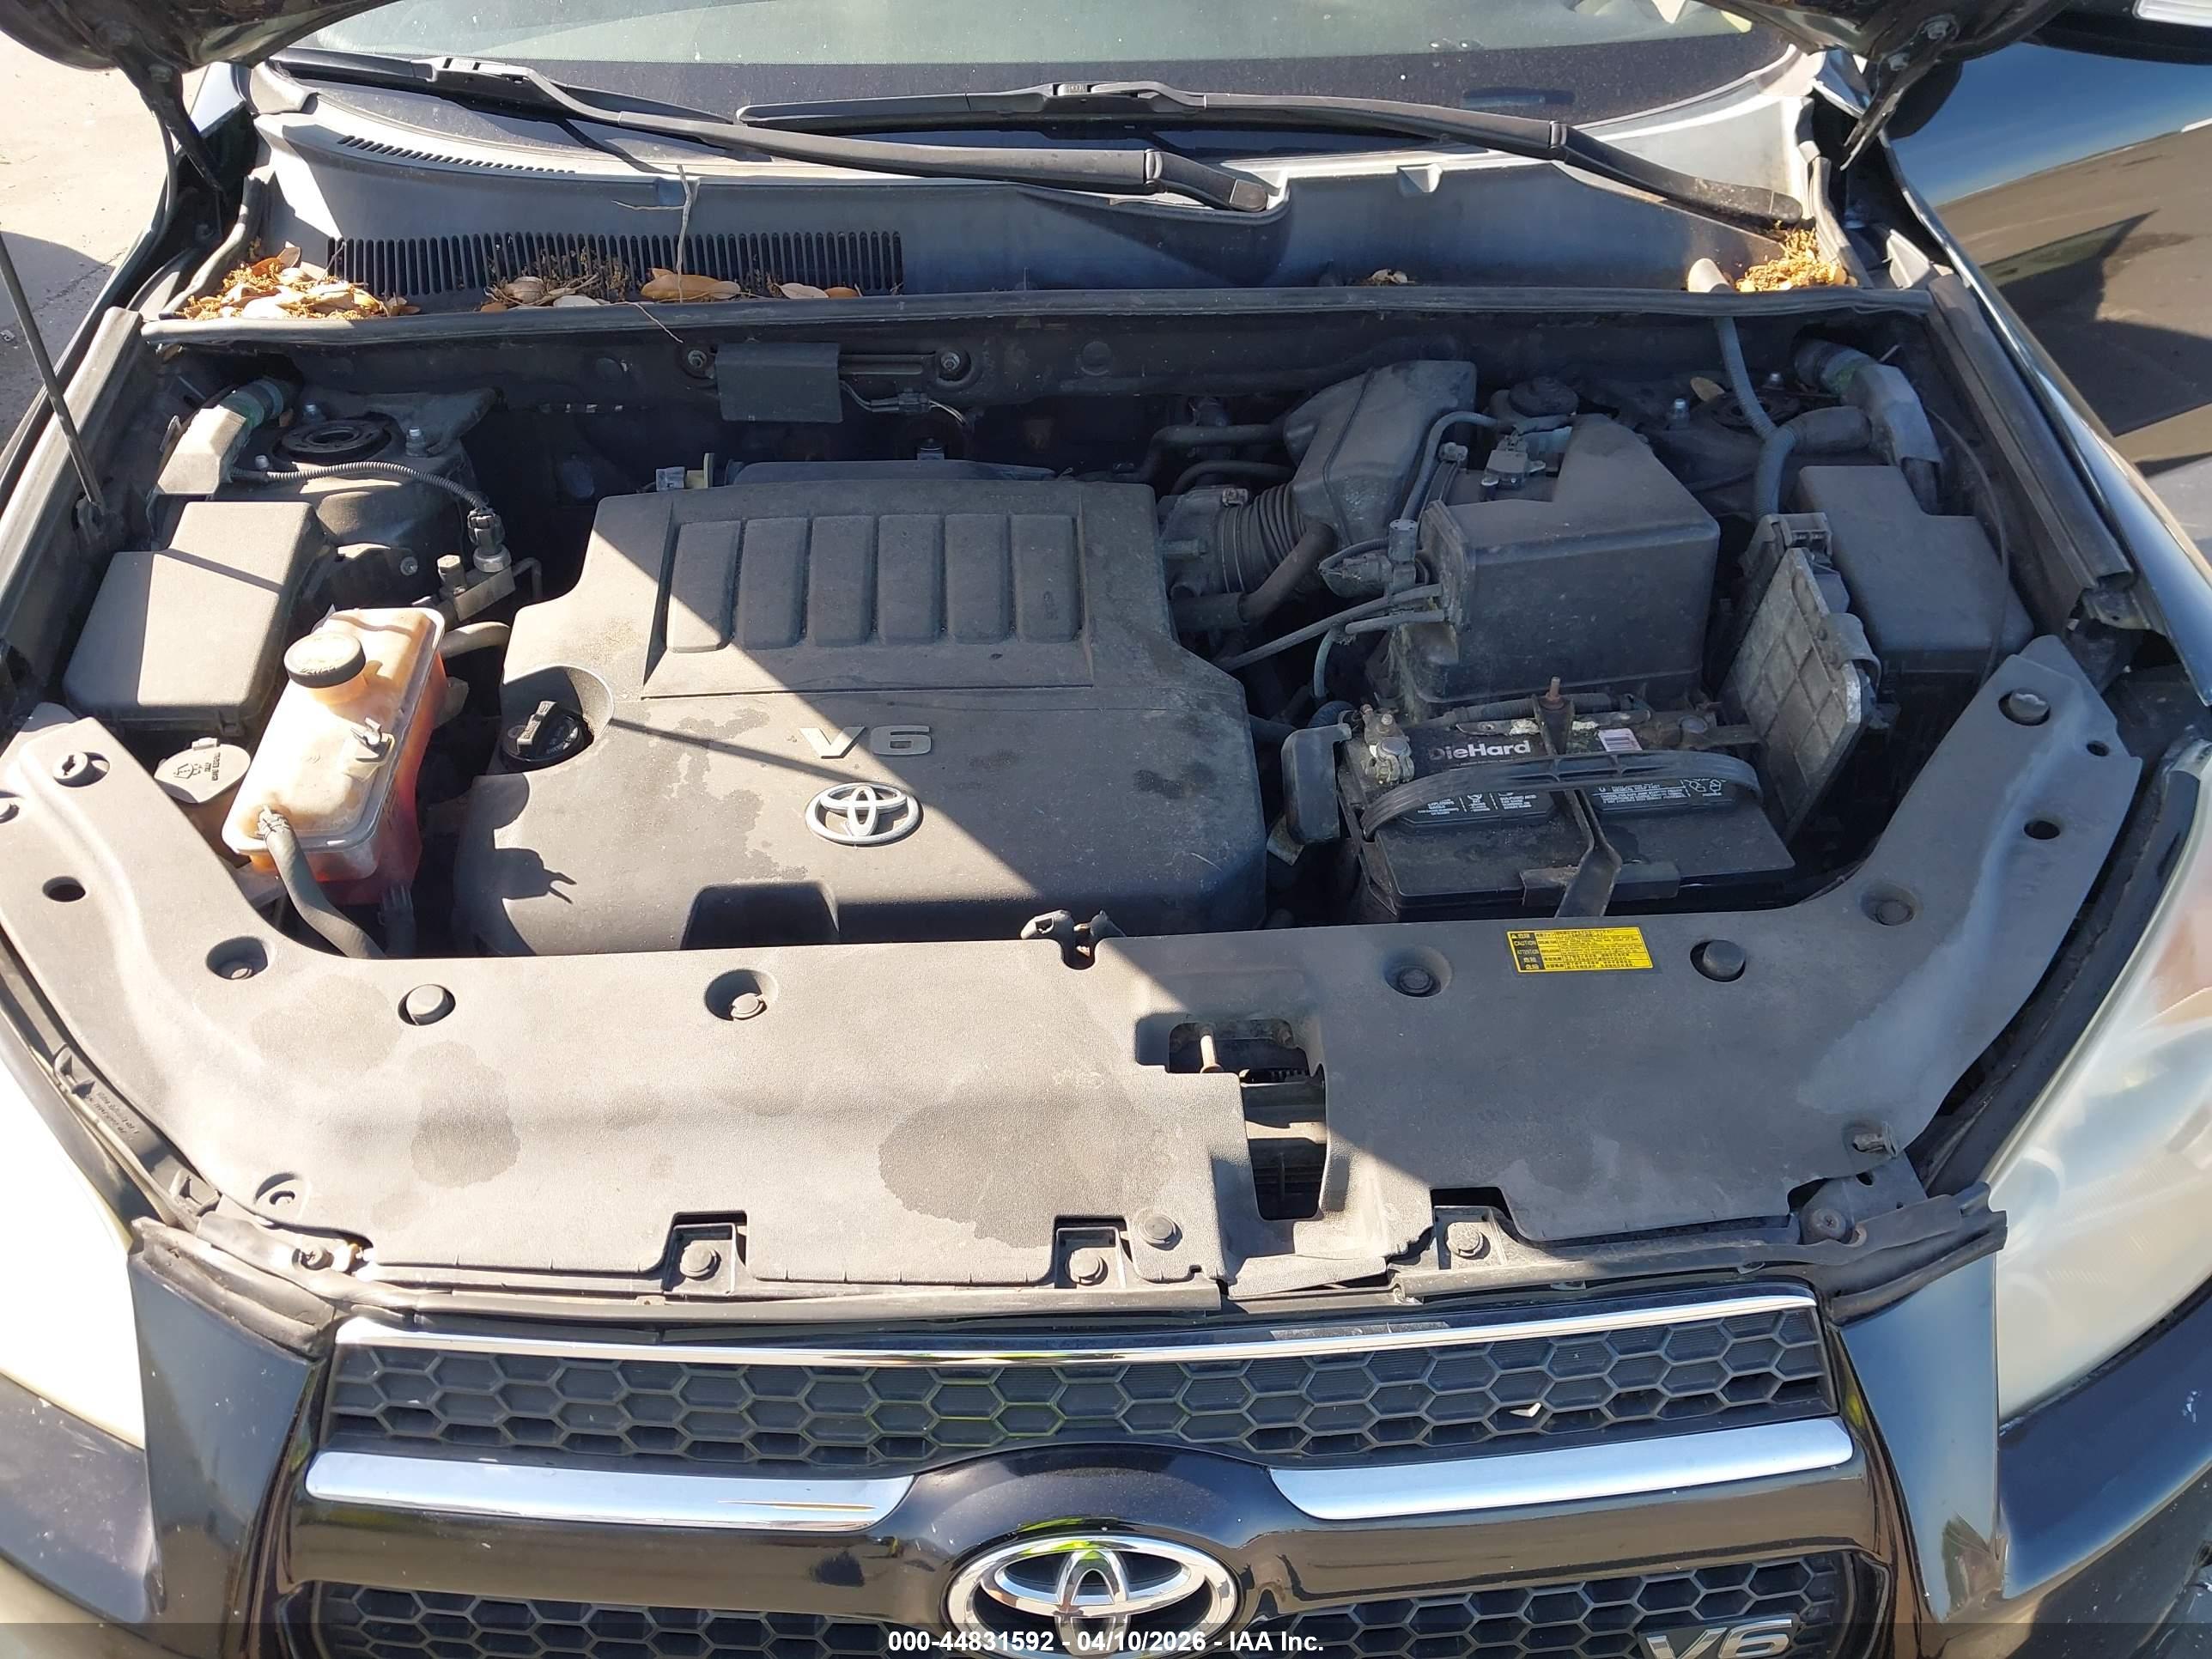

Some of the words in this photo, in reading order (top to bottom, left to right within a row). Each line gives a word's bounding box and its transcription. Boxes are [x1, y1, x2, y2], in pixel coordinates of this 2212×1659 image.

[799, 725, 932, 759] V6
[1428, 740, 1531, 761] DieHard
[1646, 1618, 1792, 1659] V6
